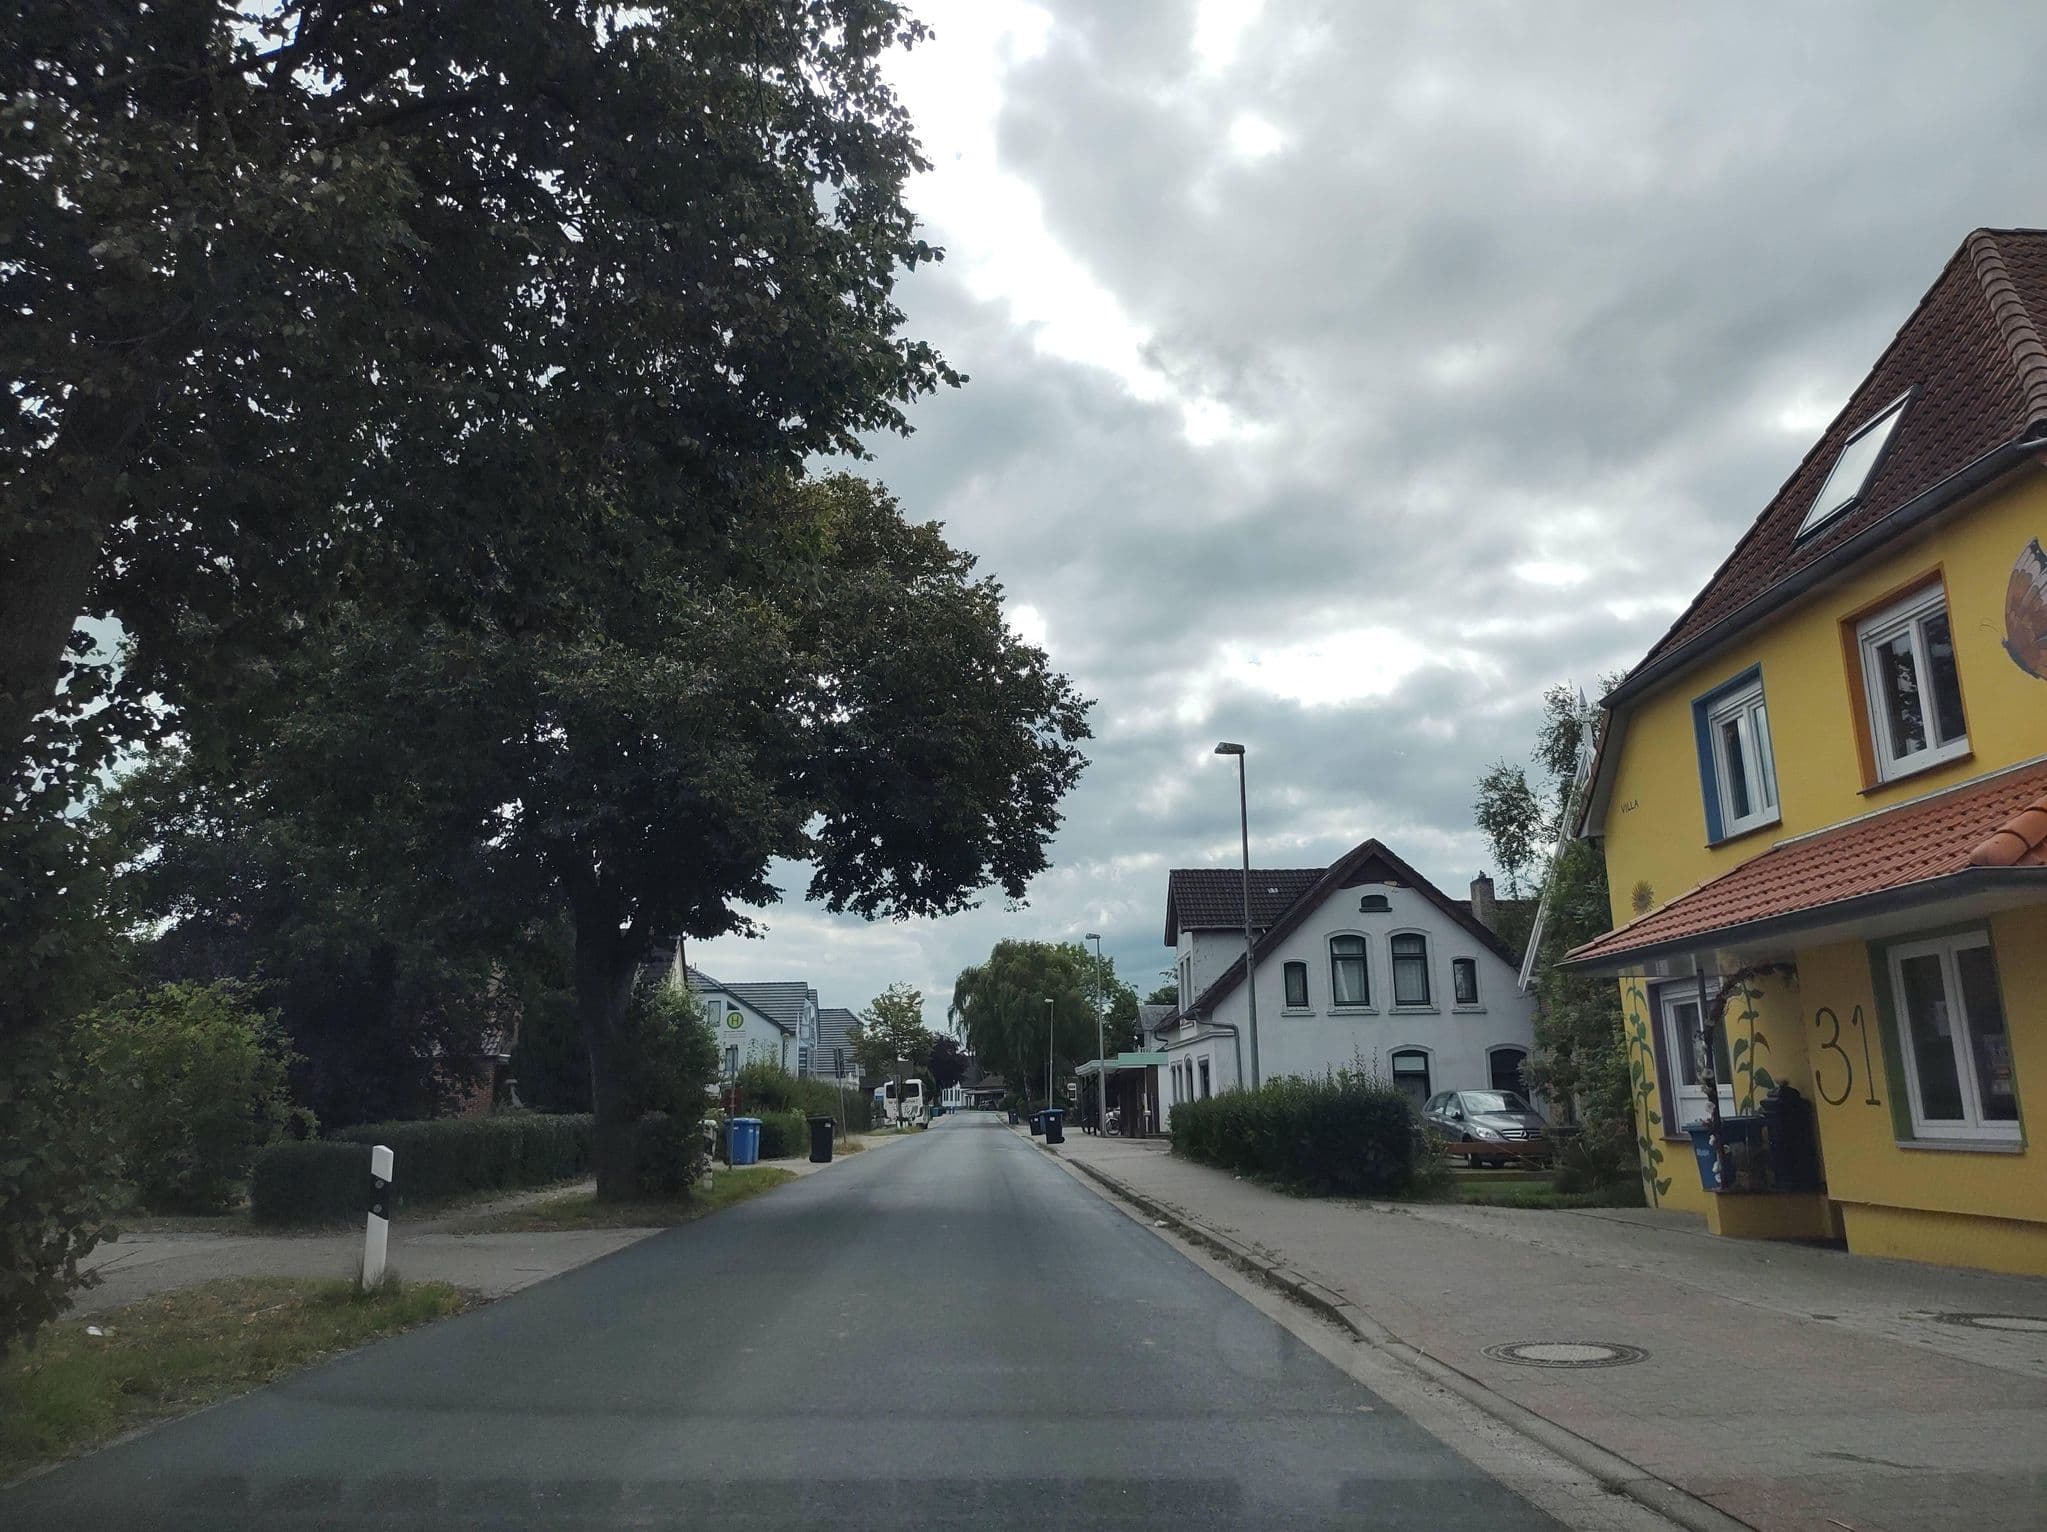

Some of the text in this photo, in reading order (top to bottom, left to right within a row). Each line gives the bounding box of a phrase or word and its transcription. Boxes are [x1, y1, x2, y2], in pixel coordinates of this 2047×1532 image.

[1620, 799, 1639, 814] VILLA
[731, 1015, 739, 1026] H
[1816, 1005, 1881, 1106] 31
